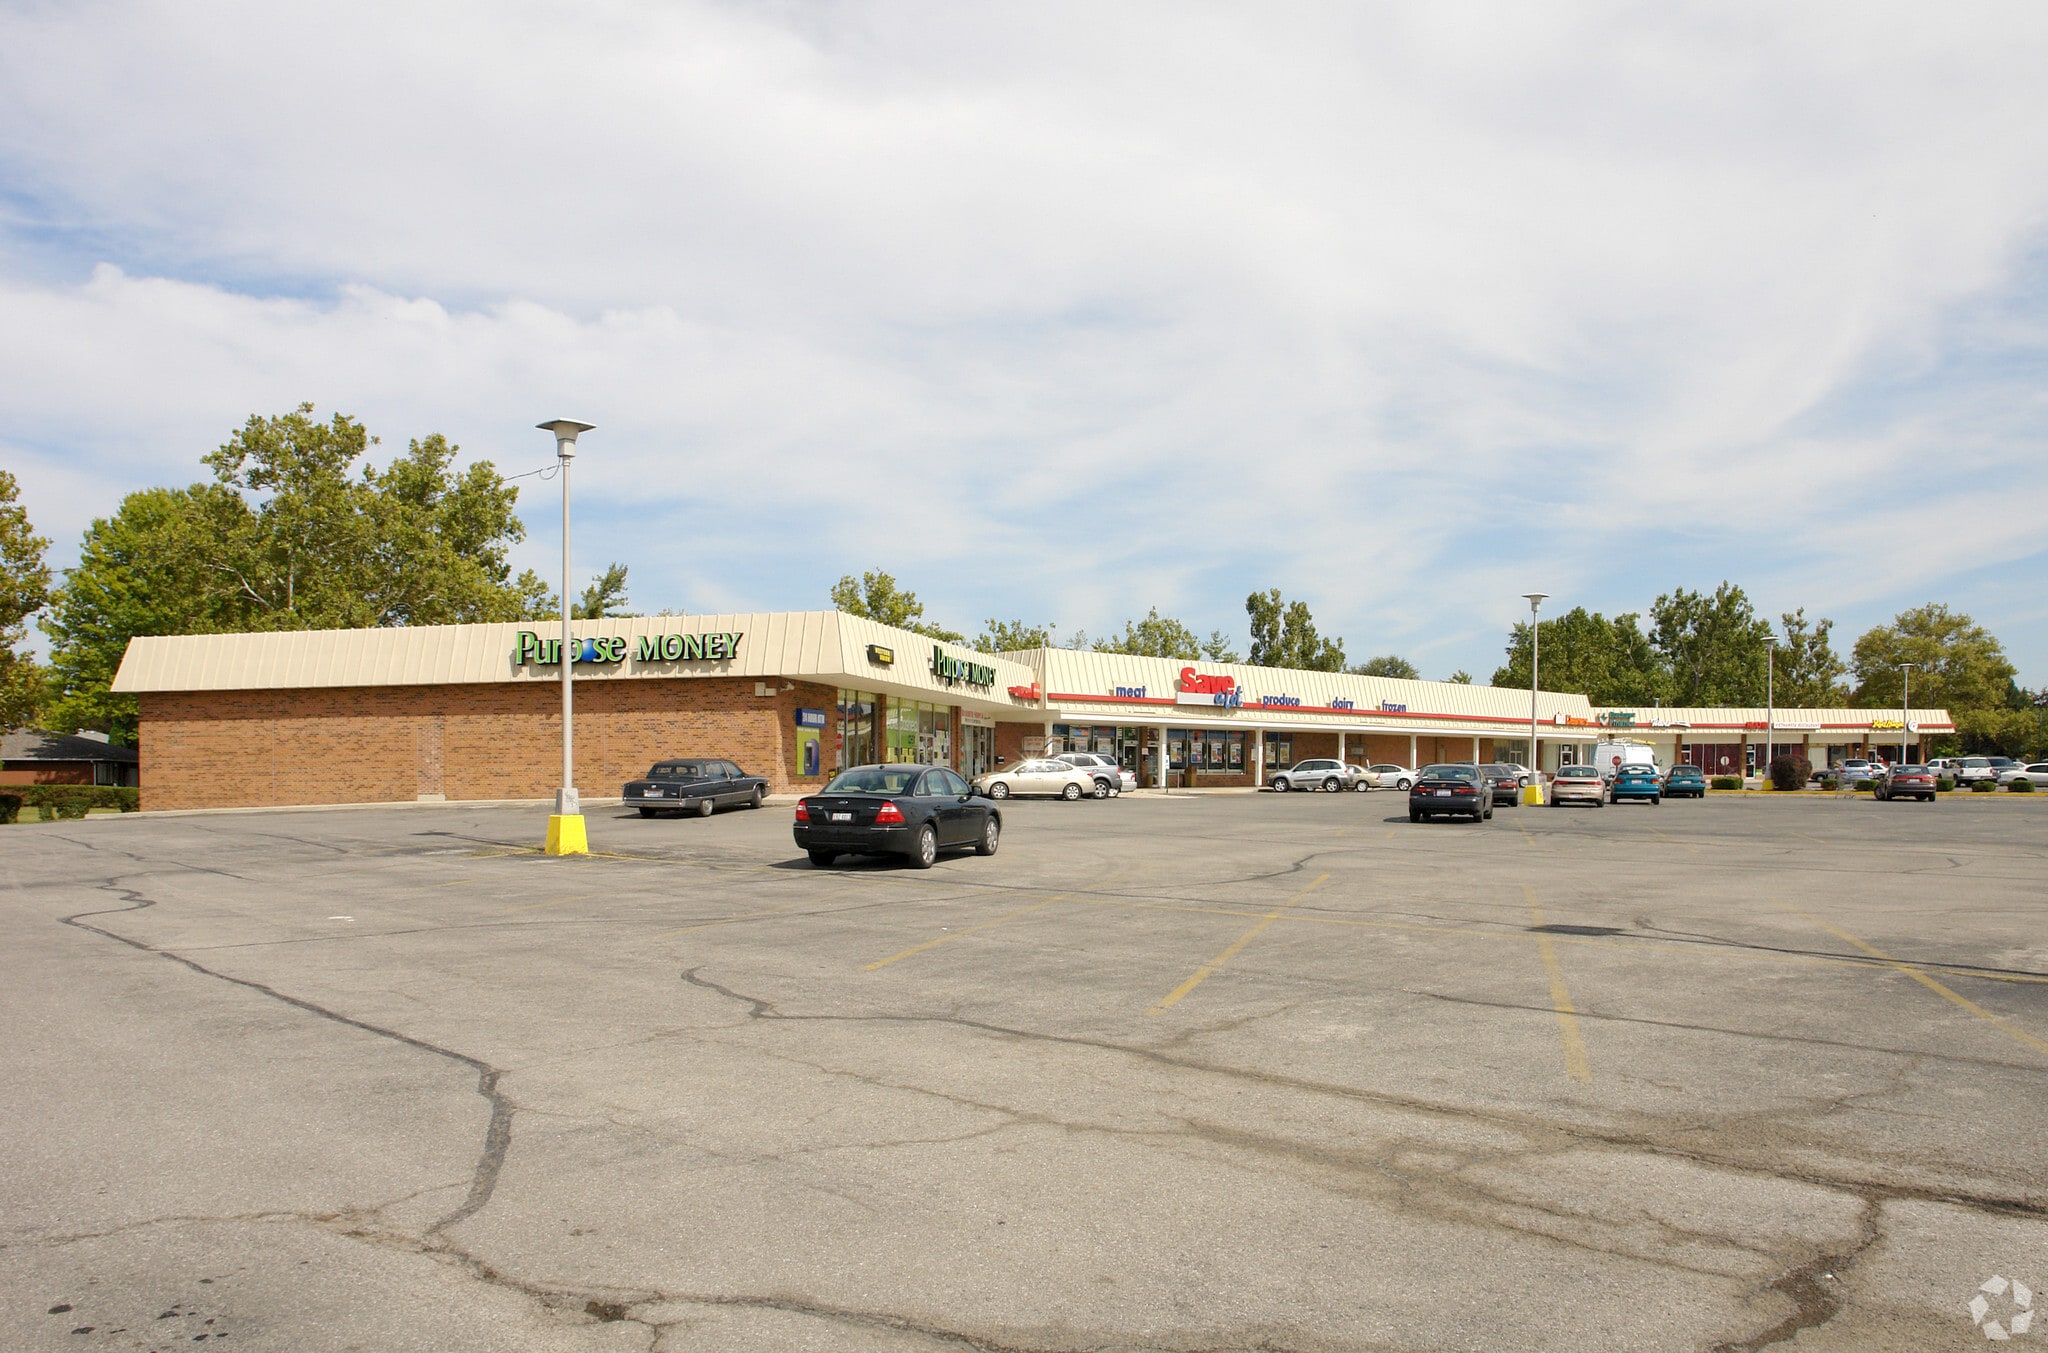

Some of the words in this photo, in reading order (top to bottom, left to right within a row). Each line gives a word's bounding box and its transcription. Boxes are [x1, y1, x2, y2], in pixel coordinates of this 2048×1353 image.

[636, 632, 743, 662] MONEY
[935, 646, 969, 687] Purpose
[971, 663, 996, 687] MONEY
[1180, 667, 1234, 695] Save
[1115, 685, 1146, 698] meat
[1263, 693, 1300, 707] produce
[1332, 696, 1354, 713] dairy
[1381, 699, 1407, 712] frozen
